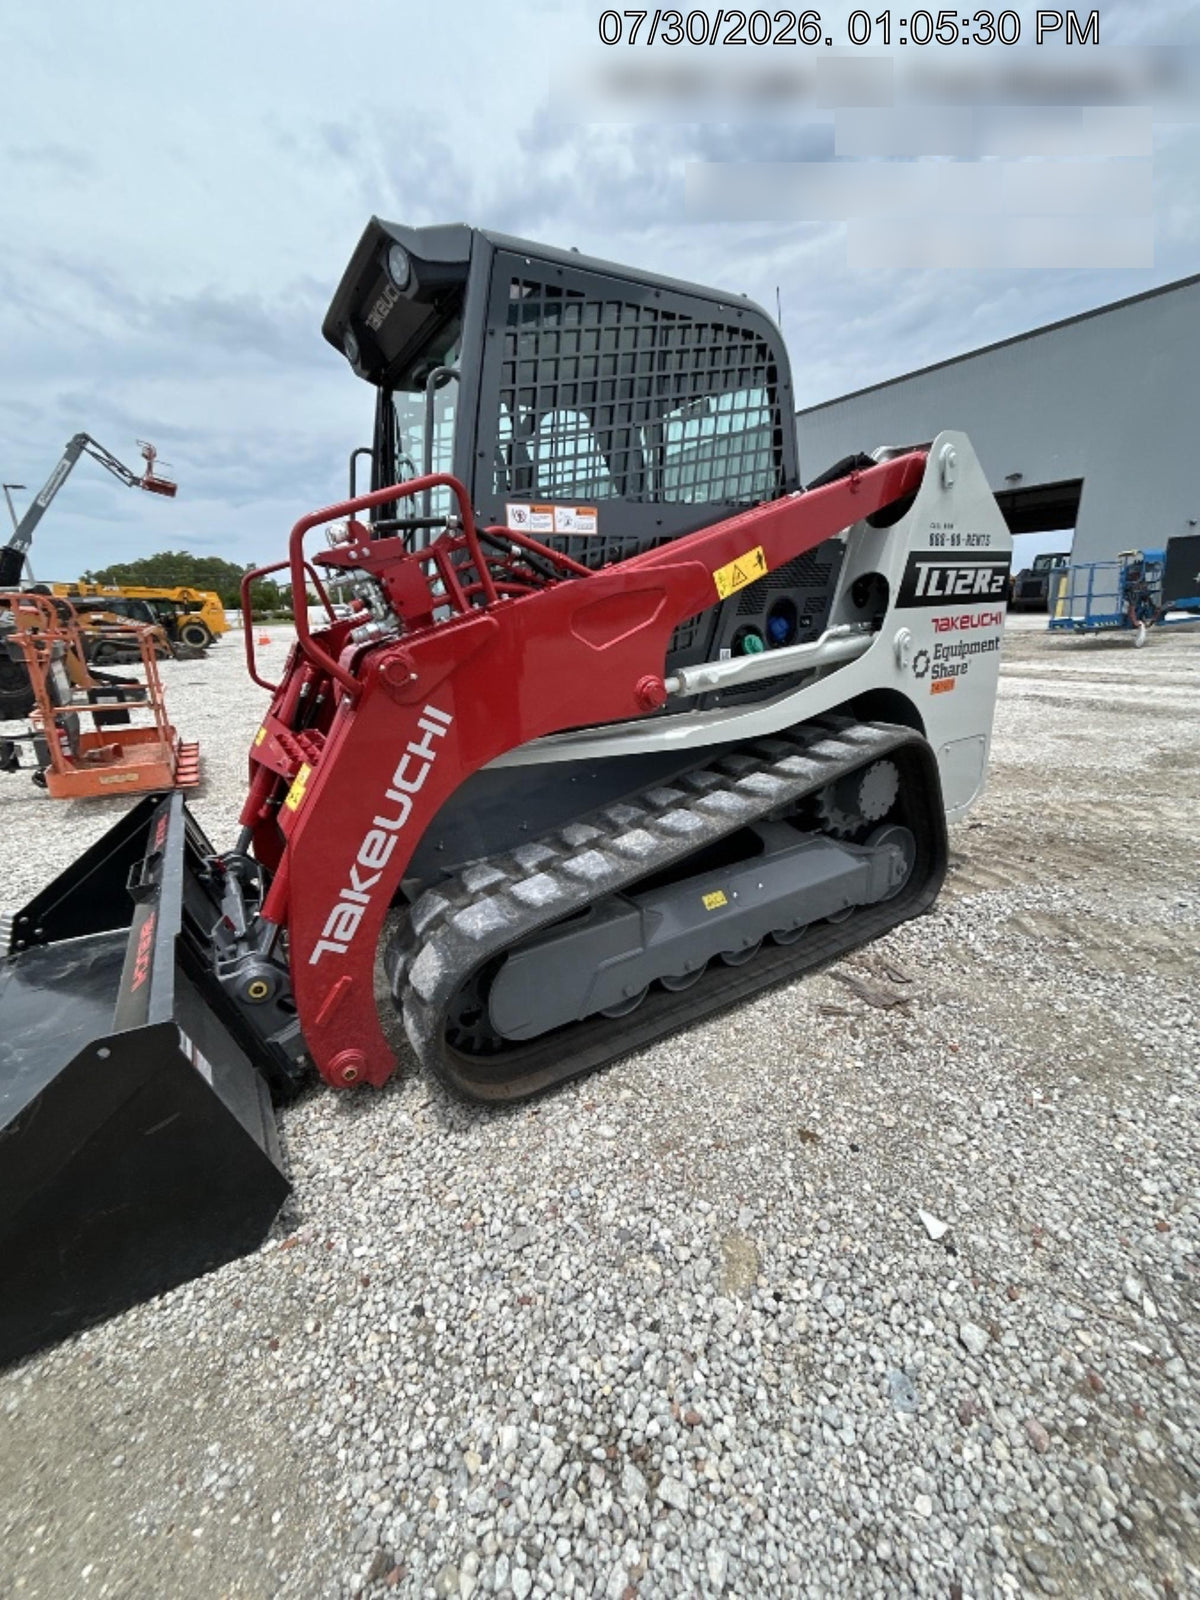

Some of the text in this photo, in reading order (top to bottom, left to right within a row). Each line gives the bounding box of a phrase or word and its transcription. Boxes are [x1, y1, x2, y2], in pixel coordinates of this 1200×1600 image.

[365, 283, 398, 331] TAKEUC
[931, 611, 1002, 634] TAKEUCHI
[933, 636, 1000, 661] Equipment
[931, 660, 969, 680] Share
[308, 704, 453, 965] TAKEUCHI
